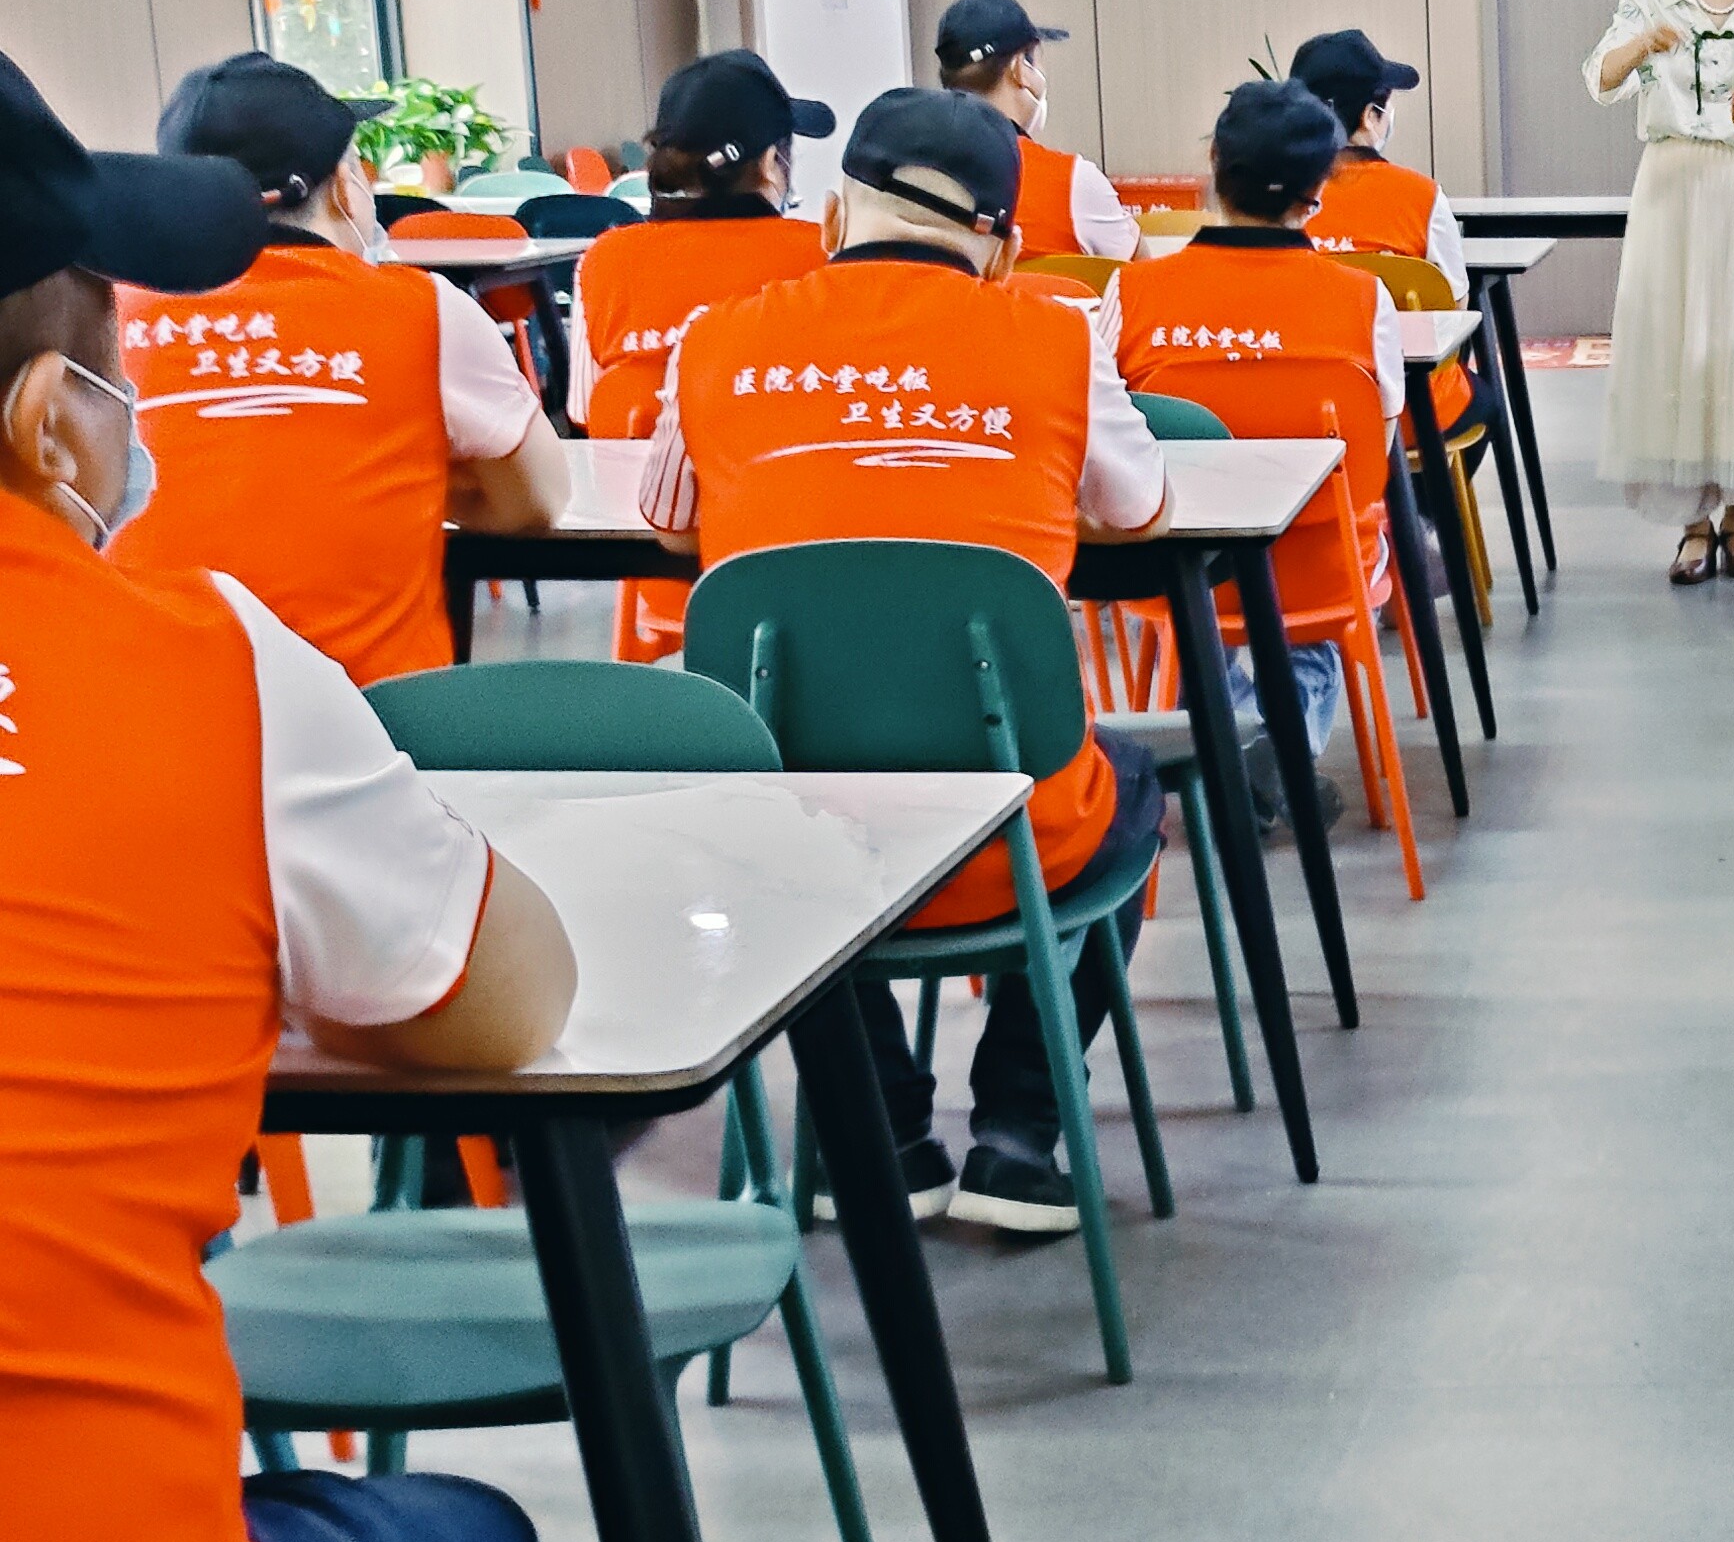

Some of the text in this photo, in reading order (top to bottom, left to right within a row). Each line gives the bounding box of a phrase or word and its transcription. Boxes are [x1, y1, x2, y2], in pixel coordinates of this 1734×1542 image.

[1151, 324, 1283, 350] 医院食堂吃饭
[190, 346, 365, 385] 卫生又方便
[733, 362, 931, 396] 医院食堂吃饭
[840, 399, 1012, 440] 卫生又方便
